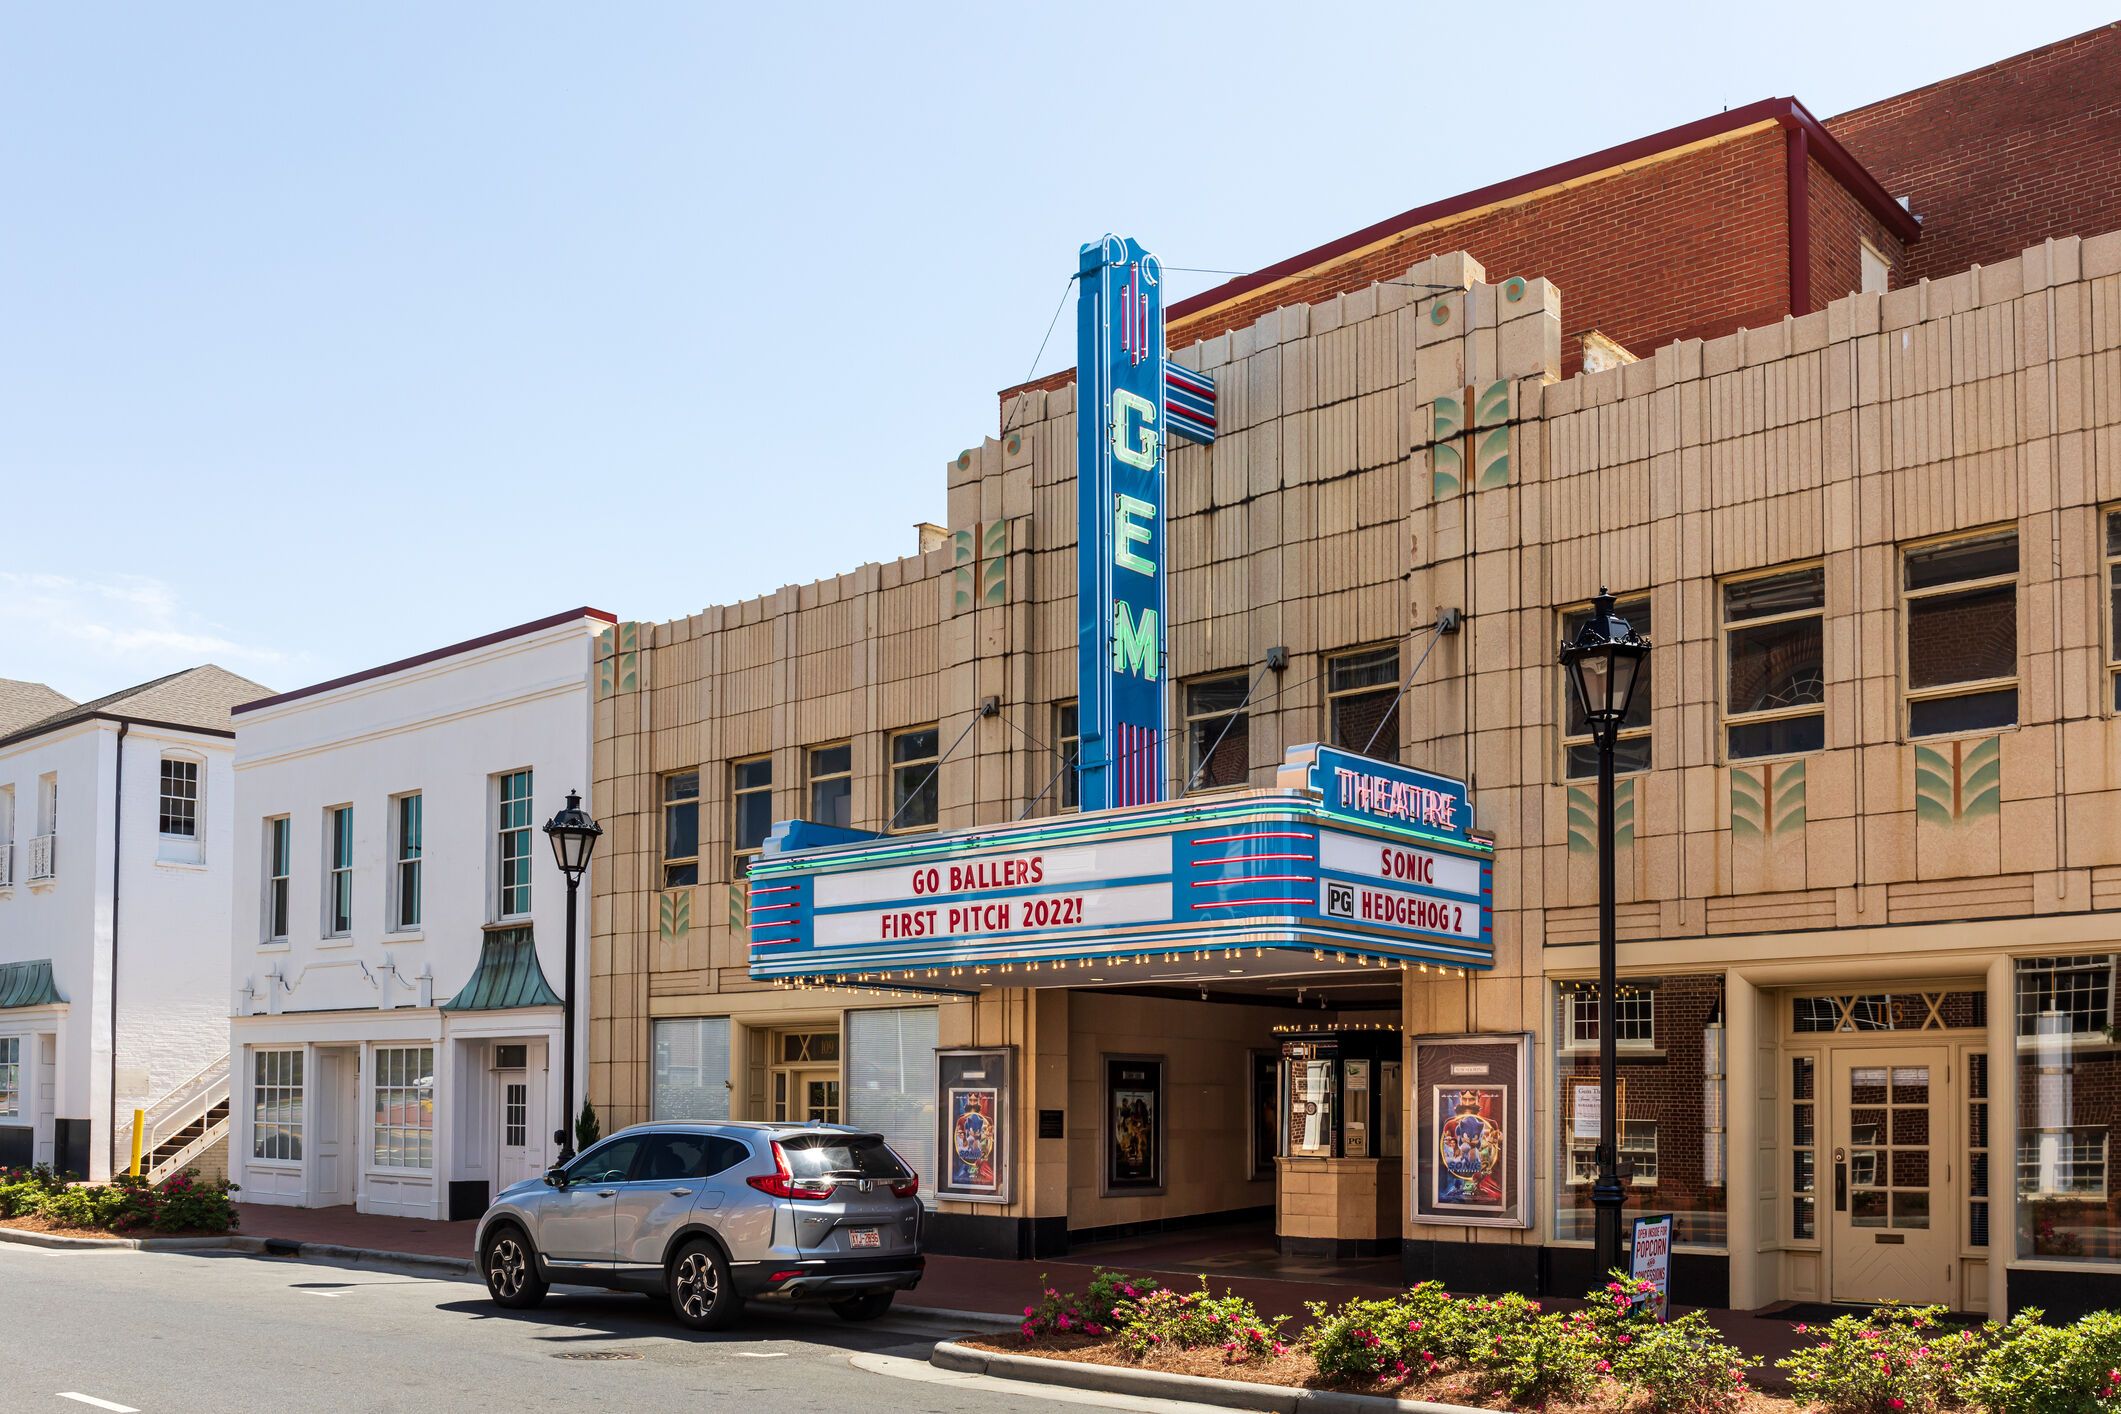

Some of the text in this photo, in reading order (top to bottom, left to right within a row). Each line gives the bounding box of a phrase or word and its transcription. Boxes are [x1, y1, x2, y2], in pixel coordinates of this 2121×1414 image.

[1112, 388, 1158, 682] GEM
[1335, 767, 1457, 831] THEATRE
[912, 856, 1043, 895] GO BALLERS
[1381, 848, 1433, 884] SONIC
[881, 897, 1083, 938] FIRST PITCH 2022!
[1330, 889, 1352, 913] PG
[1362, 891, 1462, 932] HEDGEHOG 2
[1348, 1137, 1362, 1145] PG
[1448, 1161, 1481, 1170] SONIC
[1636, 1238, 1667, 1259] POPCORN
[1638, 1229, 1647, 1239] OPEN
[1648, 1227, 1660, 1237] INSIDE
